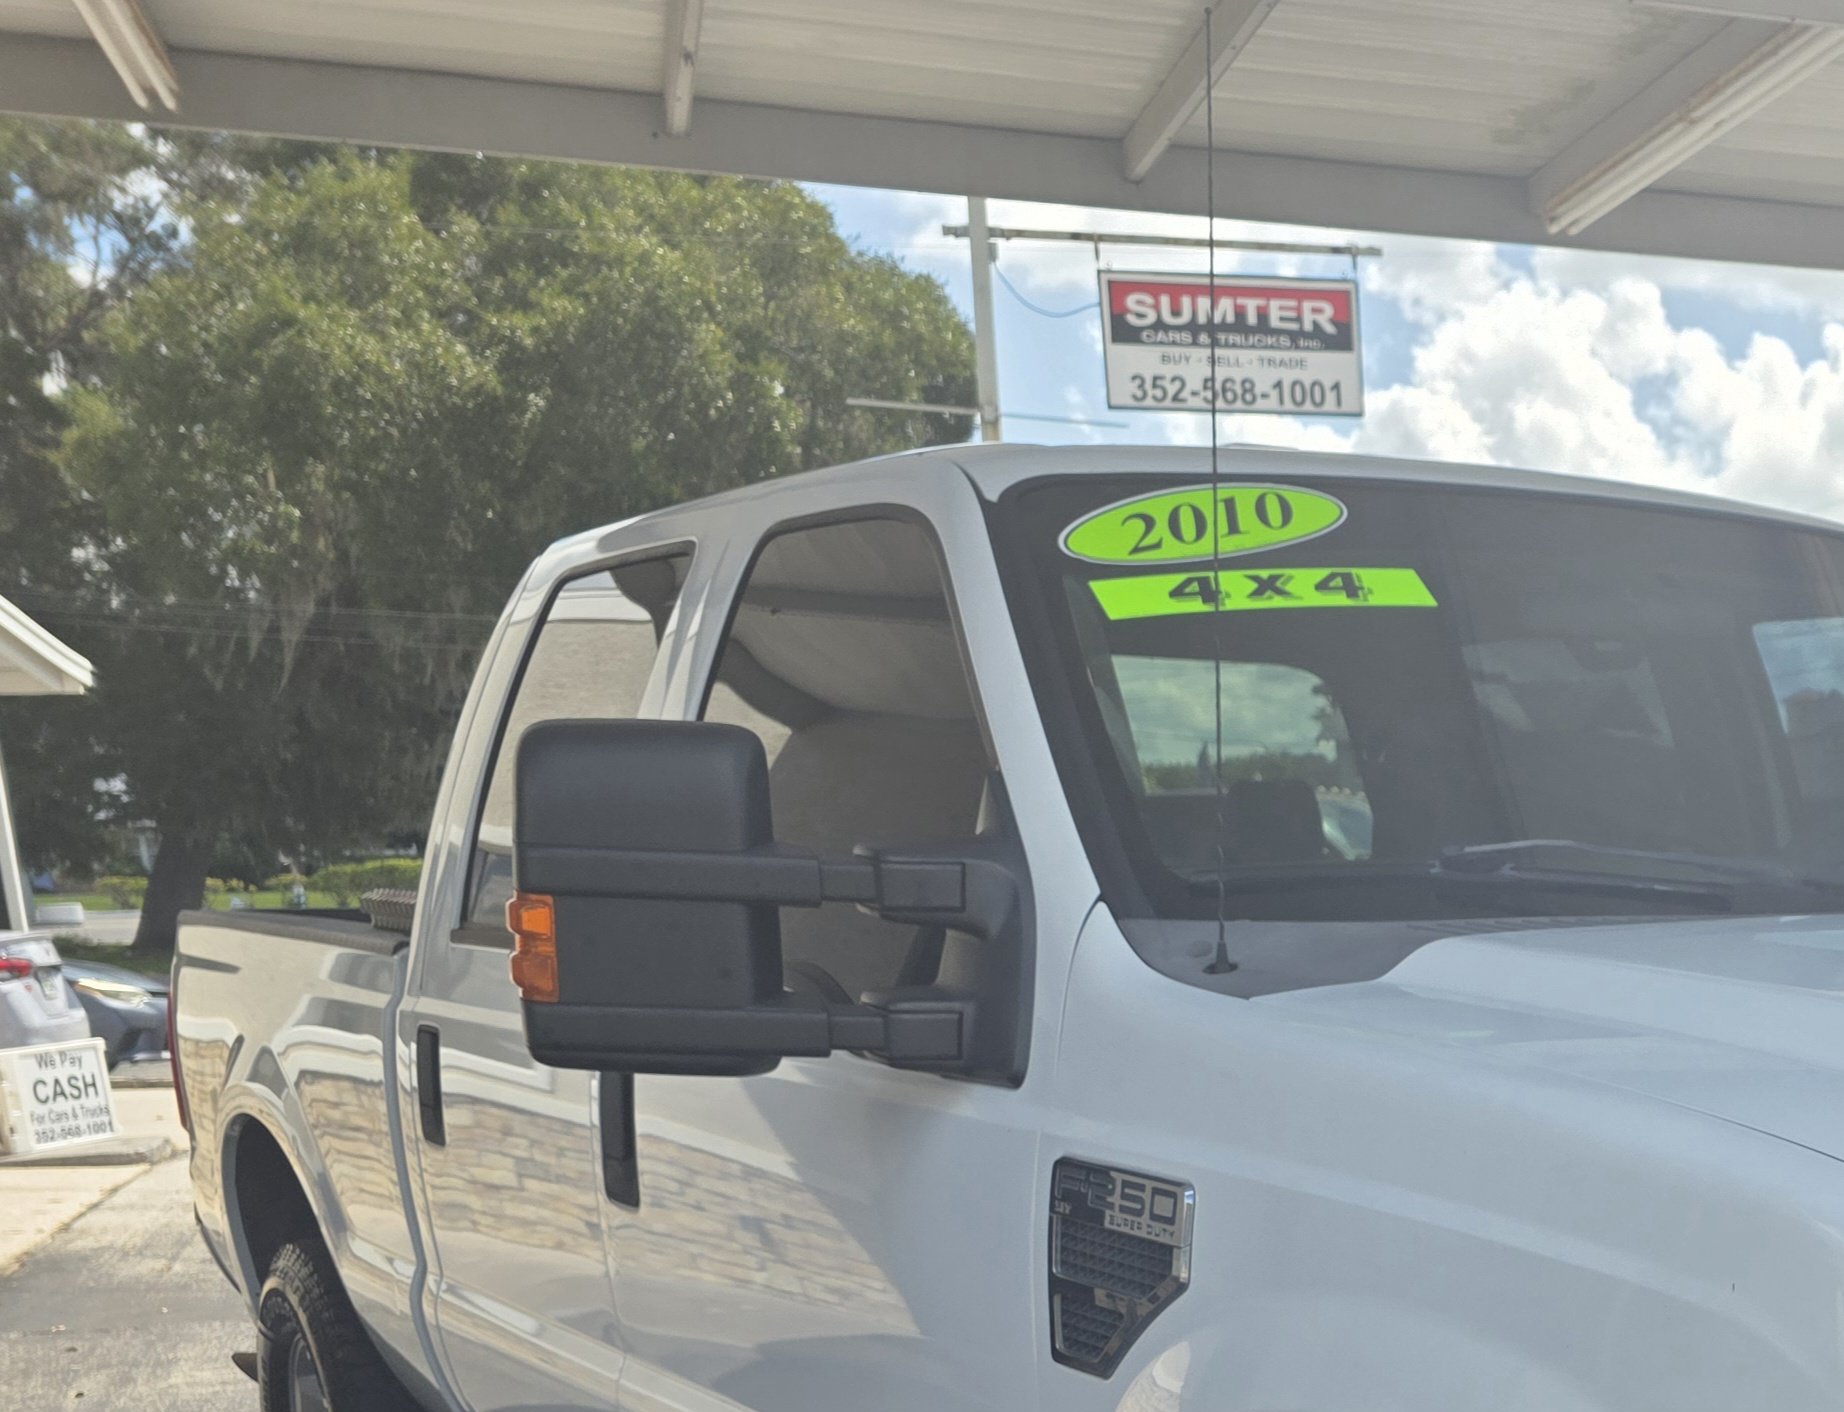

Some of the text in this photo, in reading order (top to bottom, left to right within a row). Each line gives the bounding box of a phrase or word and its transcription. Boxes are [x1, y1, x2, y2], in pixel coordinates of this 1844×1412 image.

[1124, 292, 1338, 334] SUMTER
[1140, 329, 1192, 345] CARS
[1197, 333, 1211, 345] &
[1161, 352, 1308, 370] BUY SELL TRADE
[1130, 374, 1343, 408] 352-568-1001
[1121, 492, 1293, 556] 2010
[33, 1072, 99, 1105] CASH
[1108, 1213, 1176, 1239] SUPER DUTY
